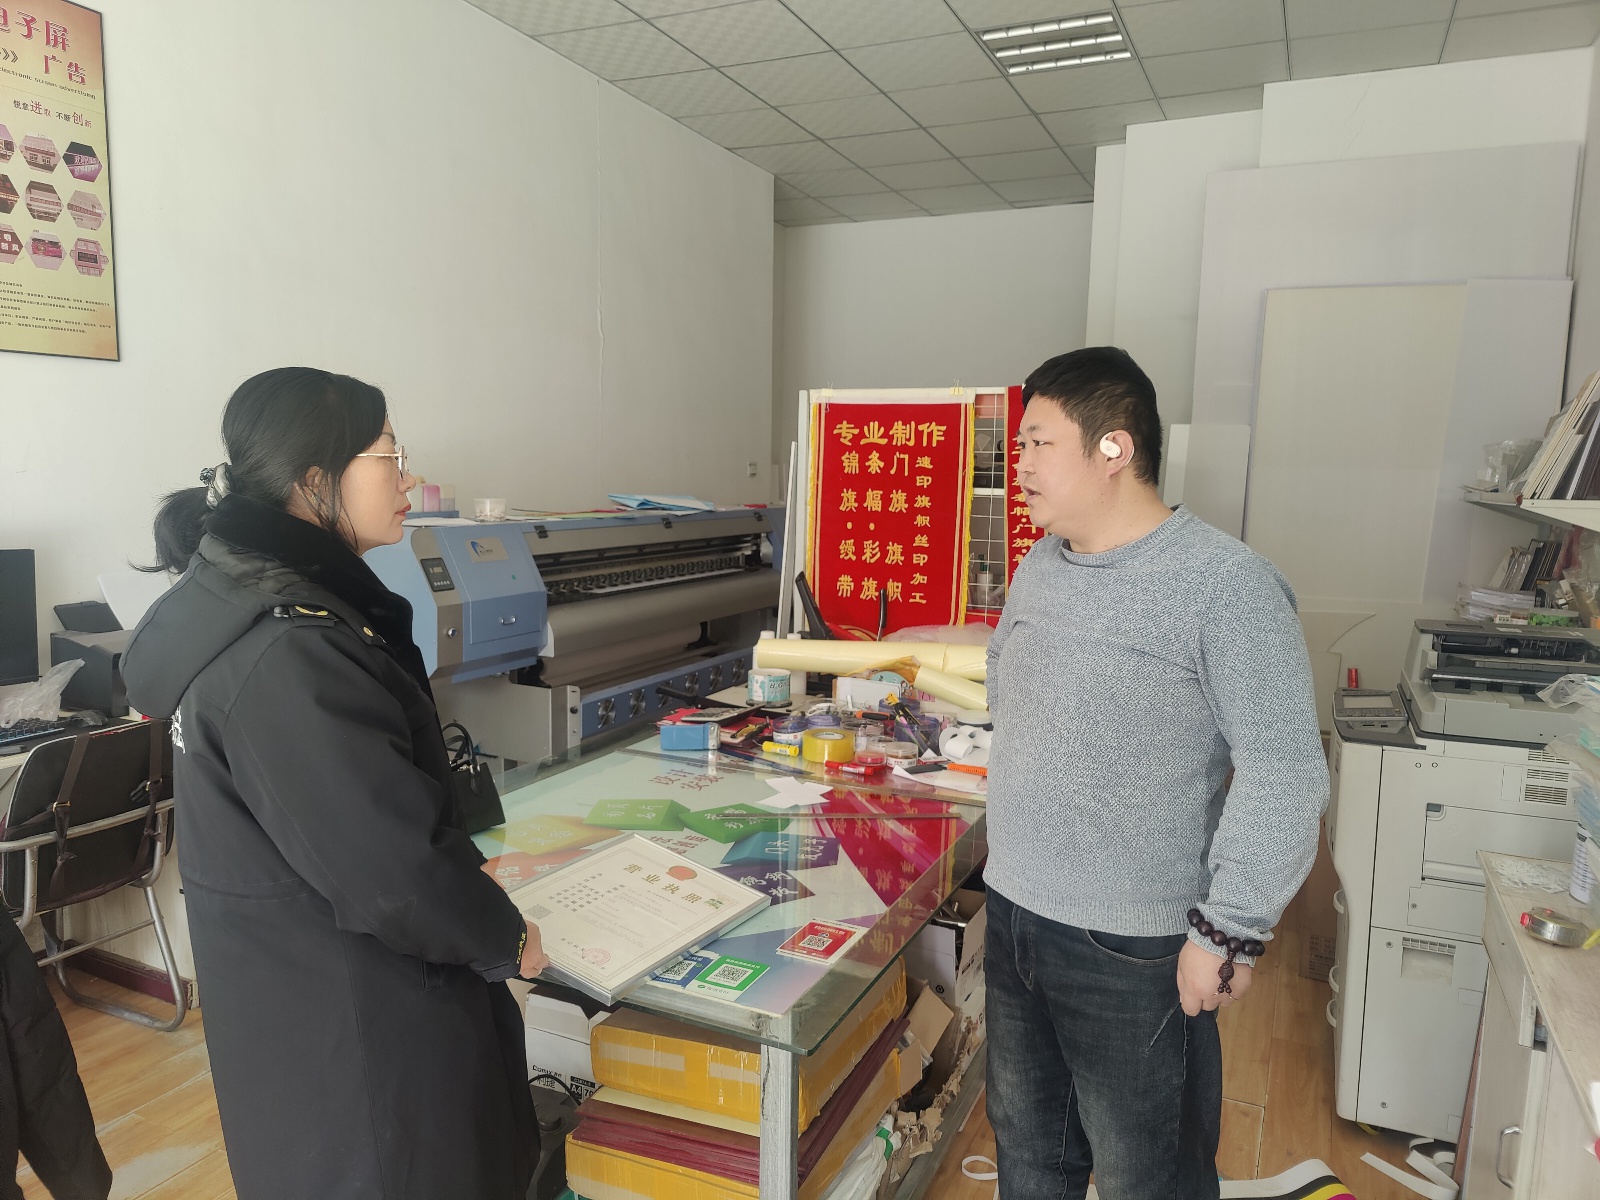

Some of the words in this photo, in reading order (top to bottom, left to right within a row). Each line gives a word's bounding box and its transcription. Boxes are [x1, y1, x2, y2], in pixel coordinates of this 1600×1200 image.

[44, 54, 86, 86] 广告
[55, 111, 92, 128] 不断创新
[832, 419, 947, 447] 专业制作
[909, 456, 934, 604] 速印旗帜丝印加工
[623, 863, 702, 903] 营业执照
